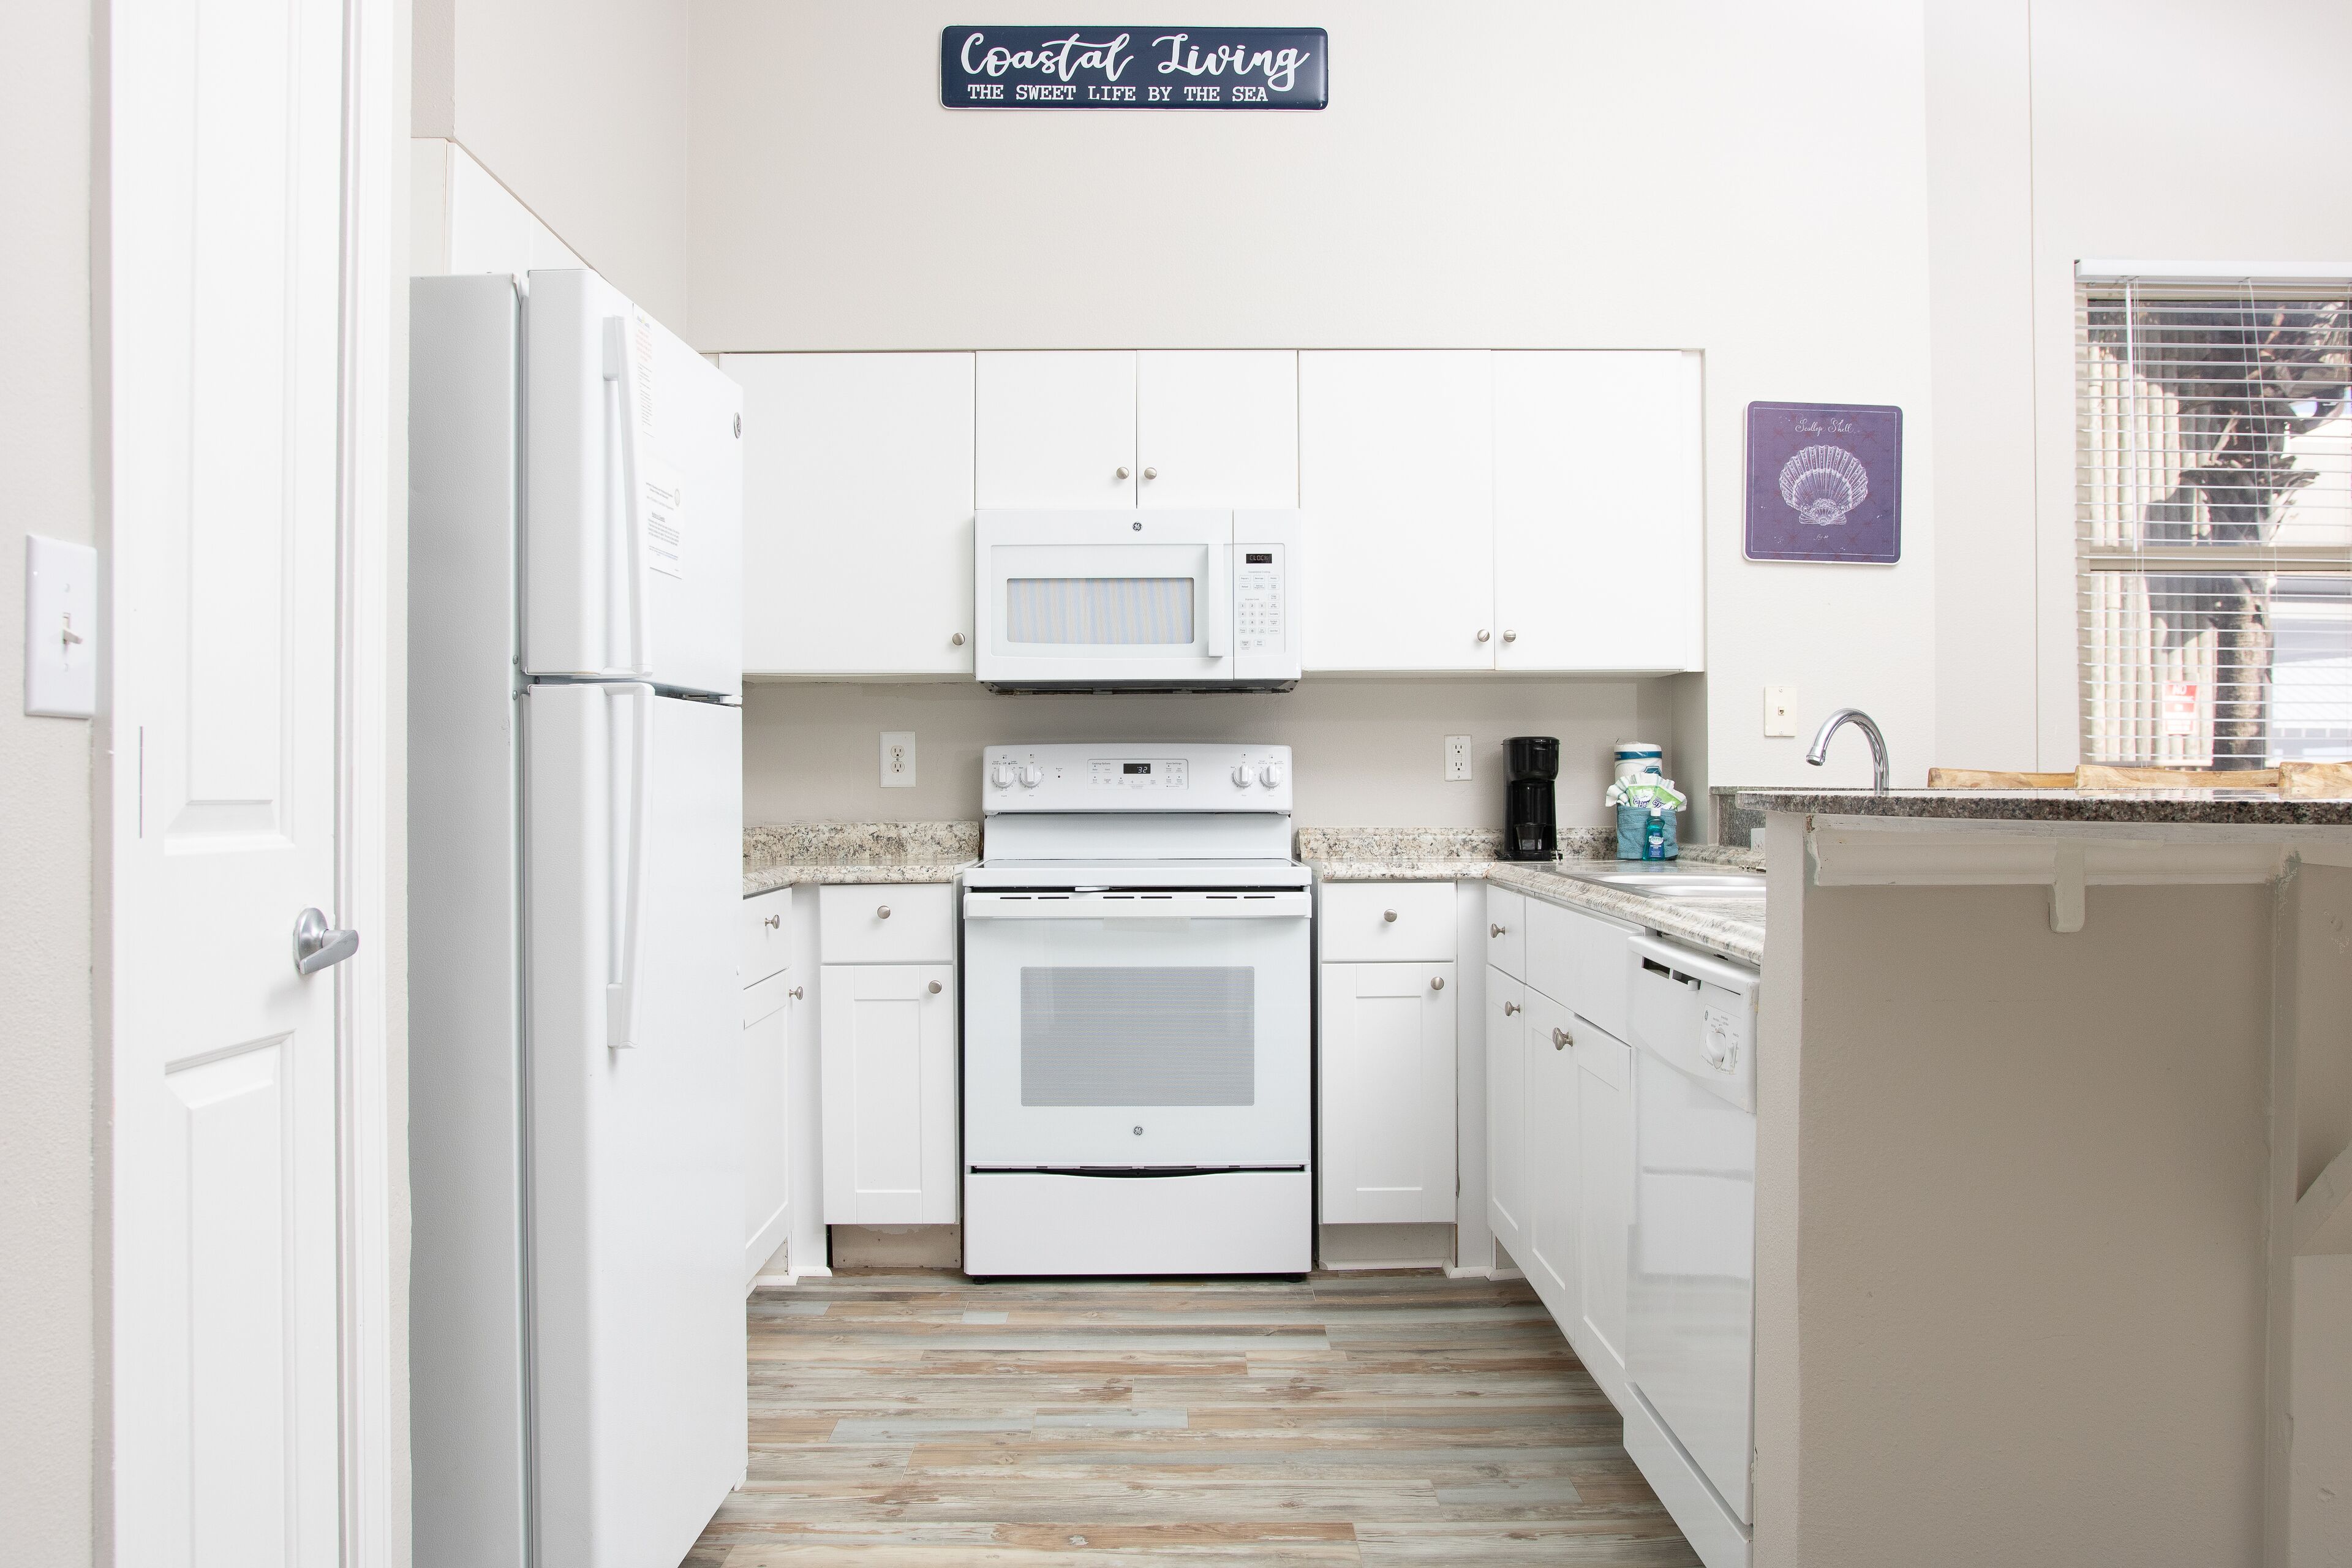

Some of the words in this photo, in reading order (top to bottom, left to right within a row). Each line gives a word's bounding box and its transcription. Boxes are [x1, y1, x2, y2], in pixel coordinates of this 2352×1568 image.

[961, 32, 1134, 81] Coastal
[1152, 34, 1310, 91] Living
[967, 84, 1004, 100] THE
[1016, 85, 1076, 100] SWEET
[1088, 86, 1136, 101] LIFE
[1148, 86, 1173, 101] BY
[1183, 86, 1221, 102] THE
[1232, 86, 1268, 102] SEA
[1795, 413, 1825, 436] Scallop
[1828, 418, 1854, 432] Shell
